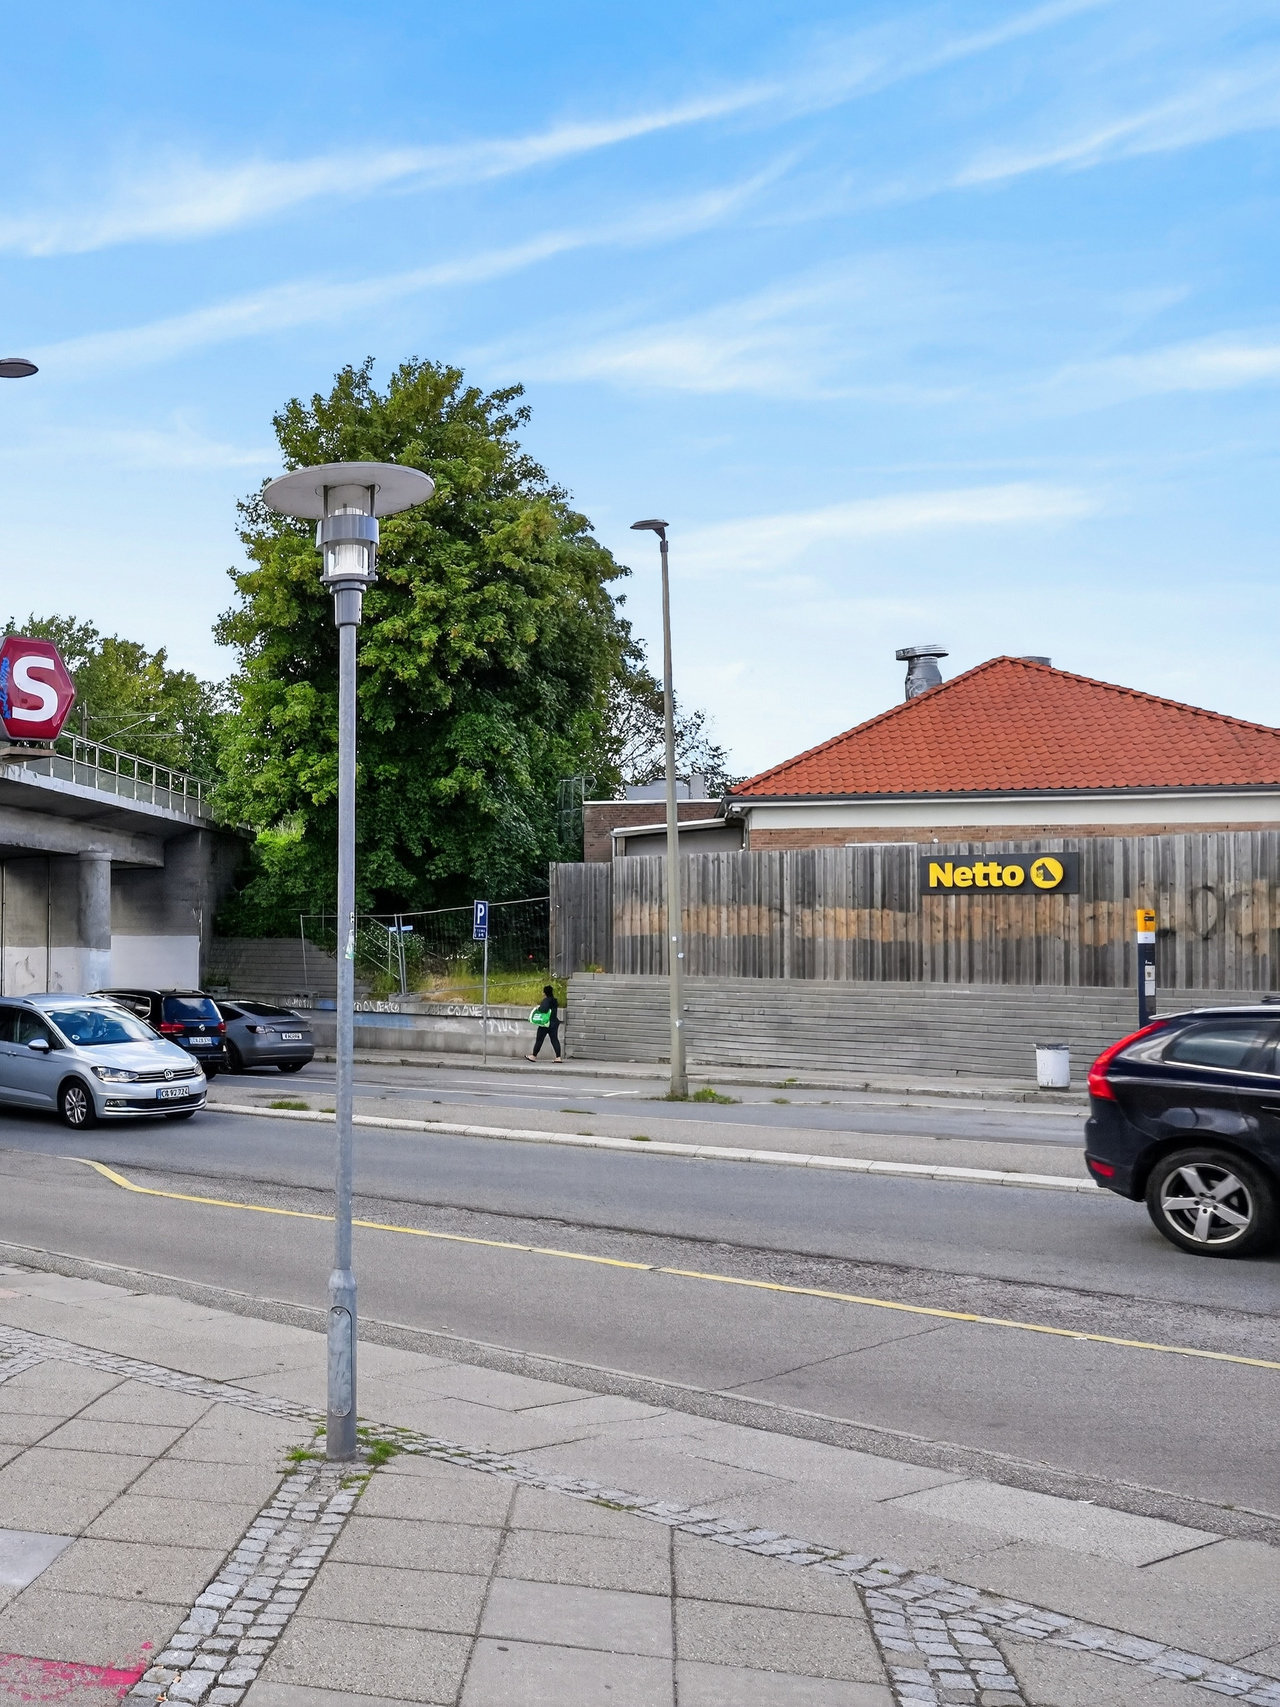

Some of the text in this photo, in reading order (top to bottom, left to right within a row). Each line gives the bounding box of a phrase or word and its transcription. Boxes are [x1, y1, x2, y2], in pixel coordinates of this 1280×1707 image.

[12, 655, 58, 722] S
[929, 861, 1025, 888] Netto
[477, 903, 485, 924] P
